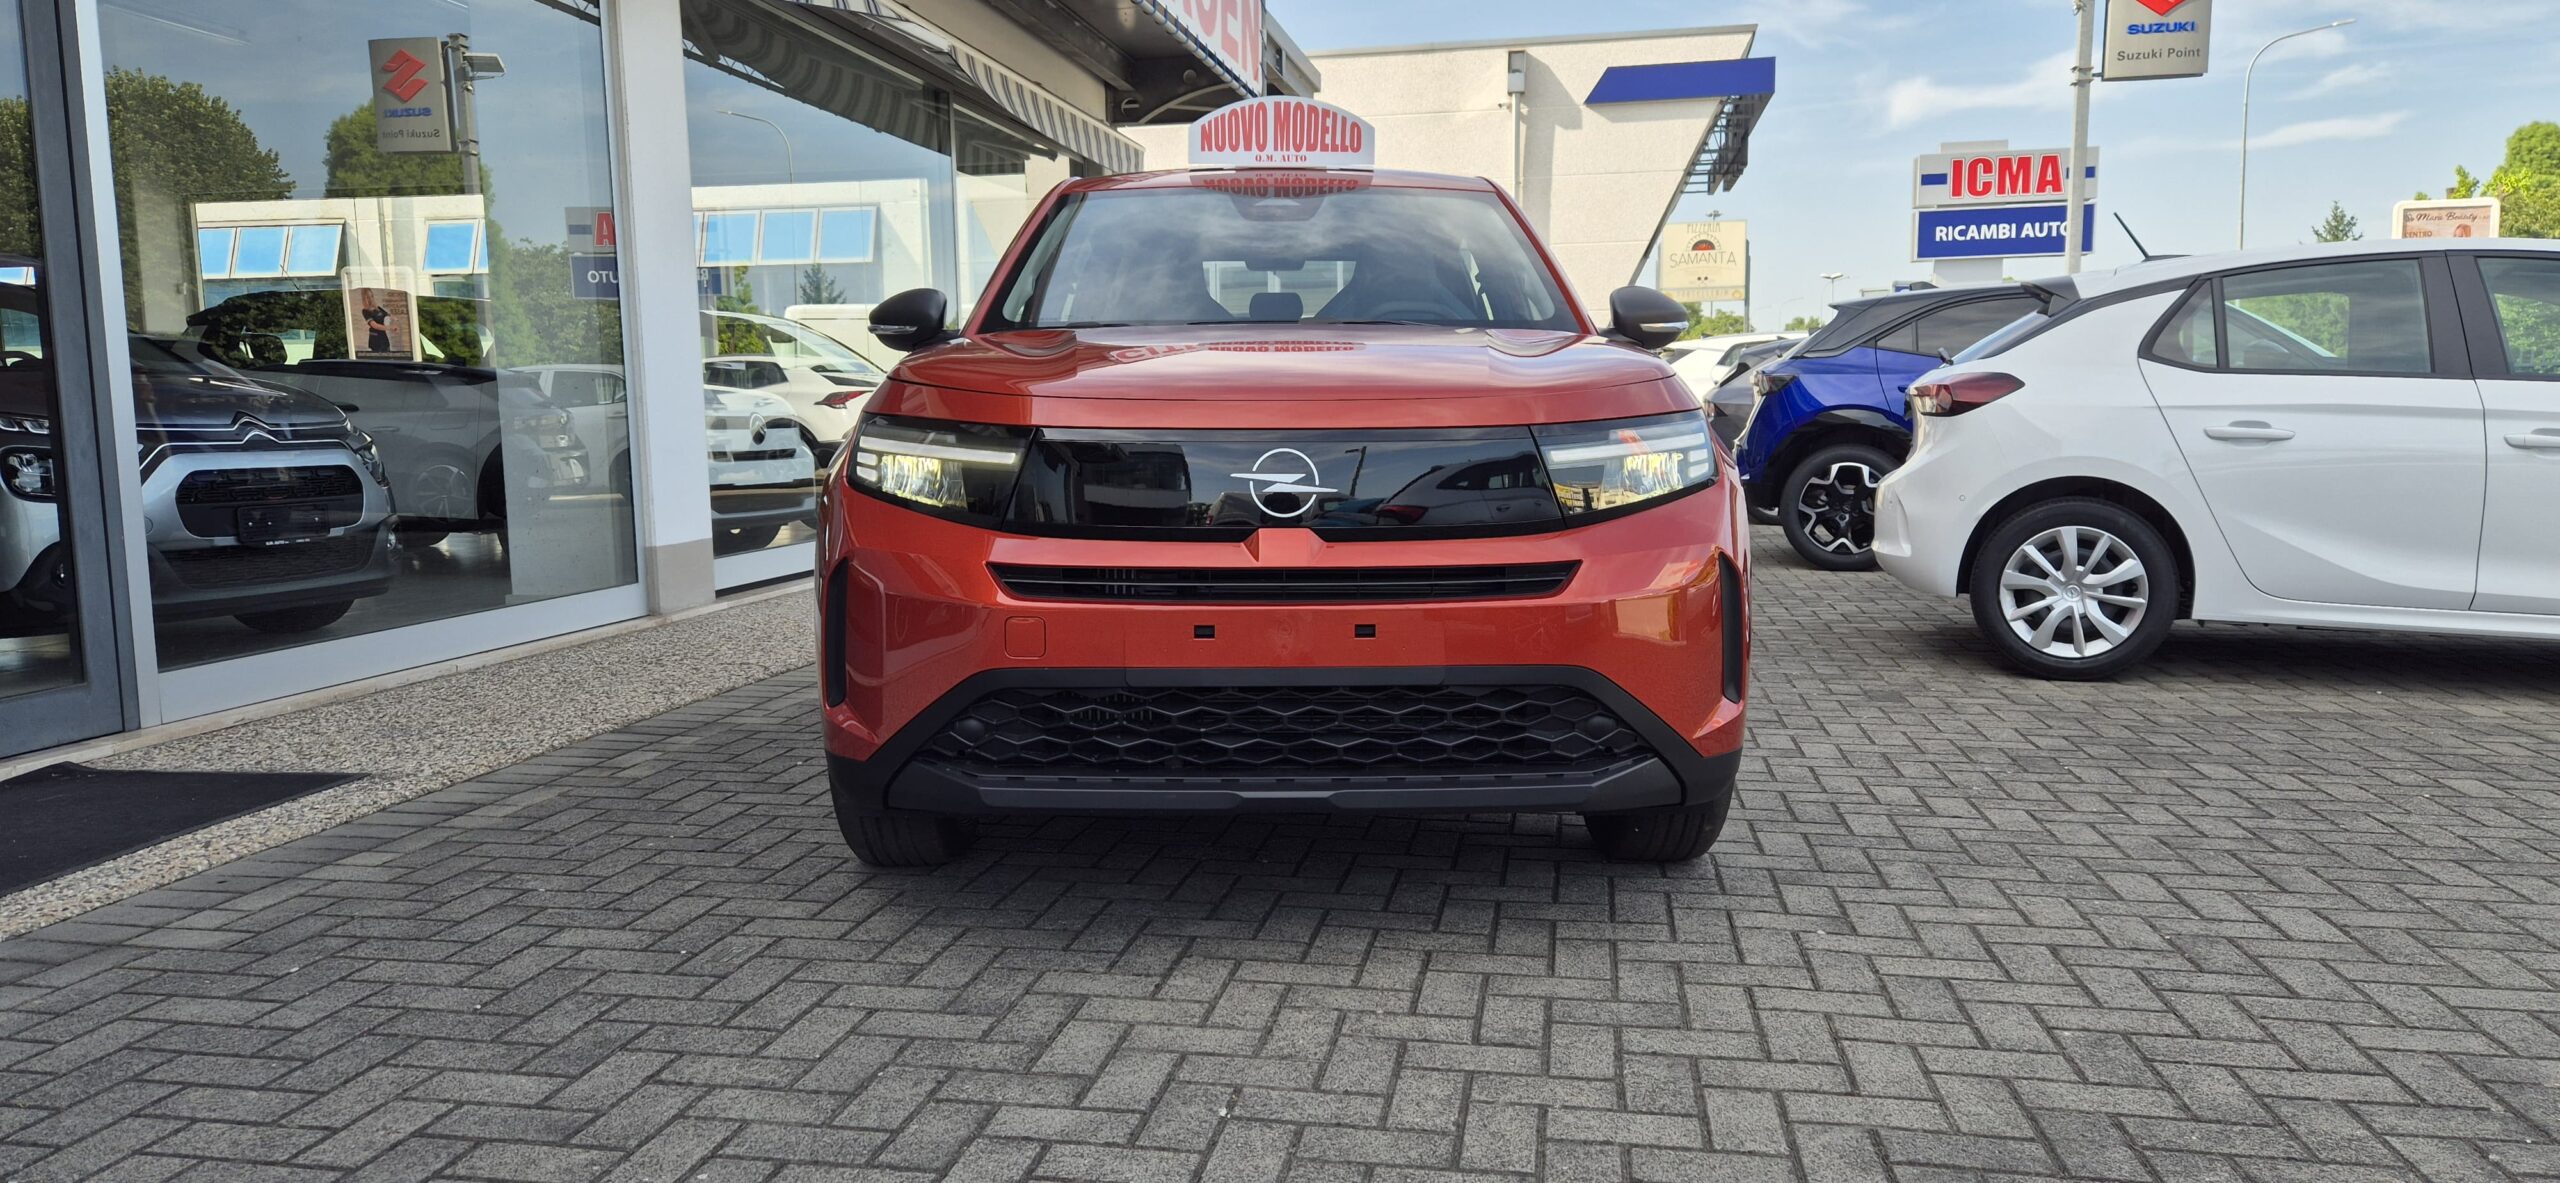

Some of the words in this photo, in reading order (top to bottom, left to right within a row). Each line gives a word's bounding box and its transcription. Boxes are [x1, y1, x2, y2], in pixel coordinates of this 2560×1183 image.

[2127, 21, 2195, 35] SUZUKI
[2116, 48, 2162, 61] Suzuki
[2167, 47, 2201, 59] Point
[1200, 101, 1268, 153] NUOVO
[1273, 101, 1362, 153] MODELLO
[1255, 154, 1277, 163] Q.M.
[1280, 154, 1307, 163] AUTO
[1951, 153, 2064, 199] ICMA
[1935, 223, 2017, 242] RICAMBI
[1669, 251, 1737, 268] SAMANTA
